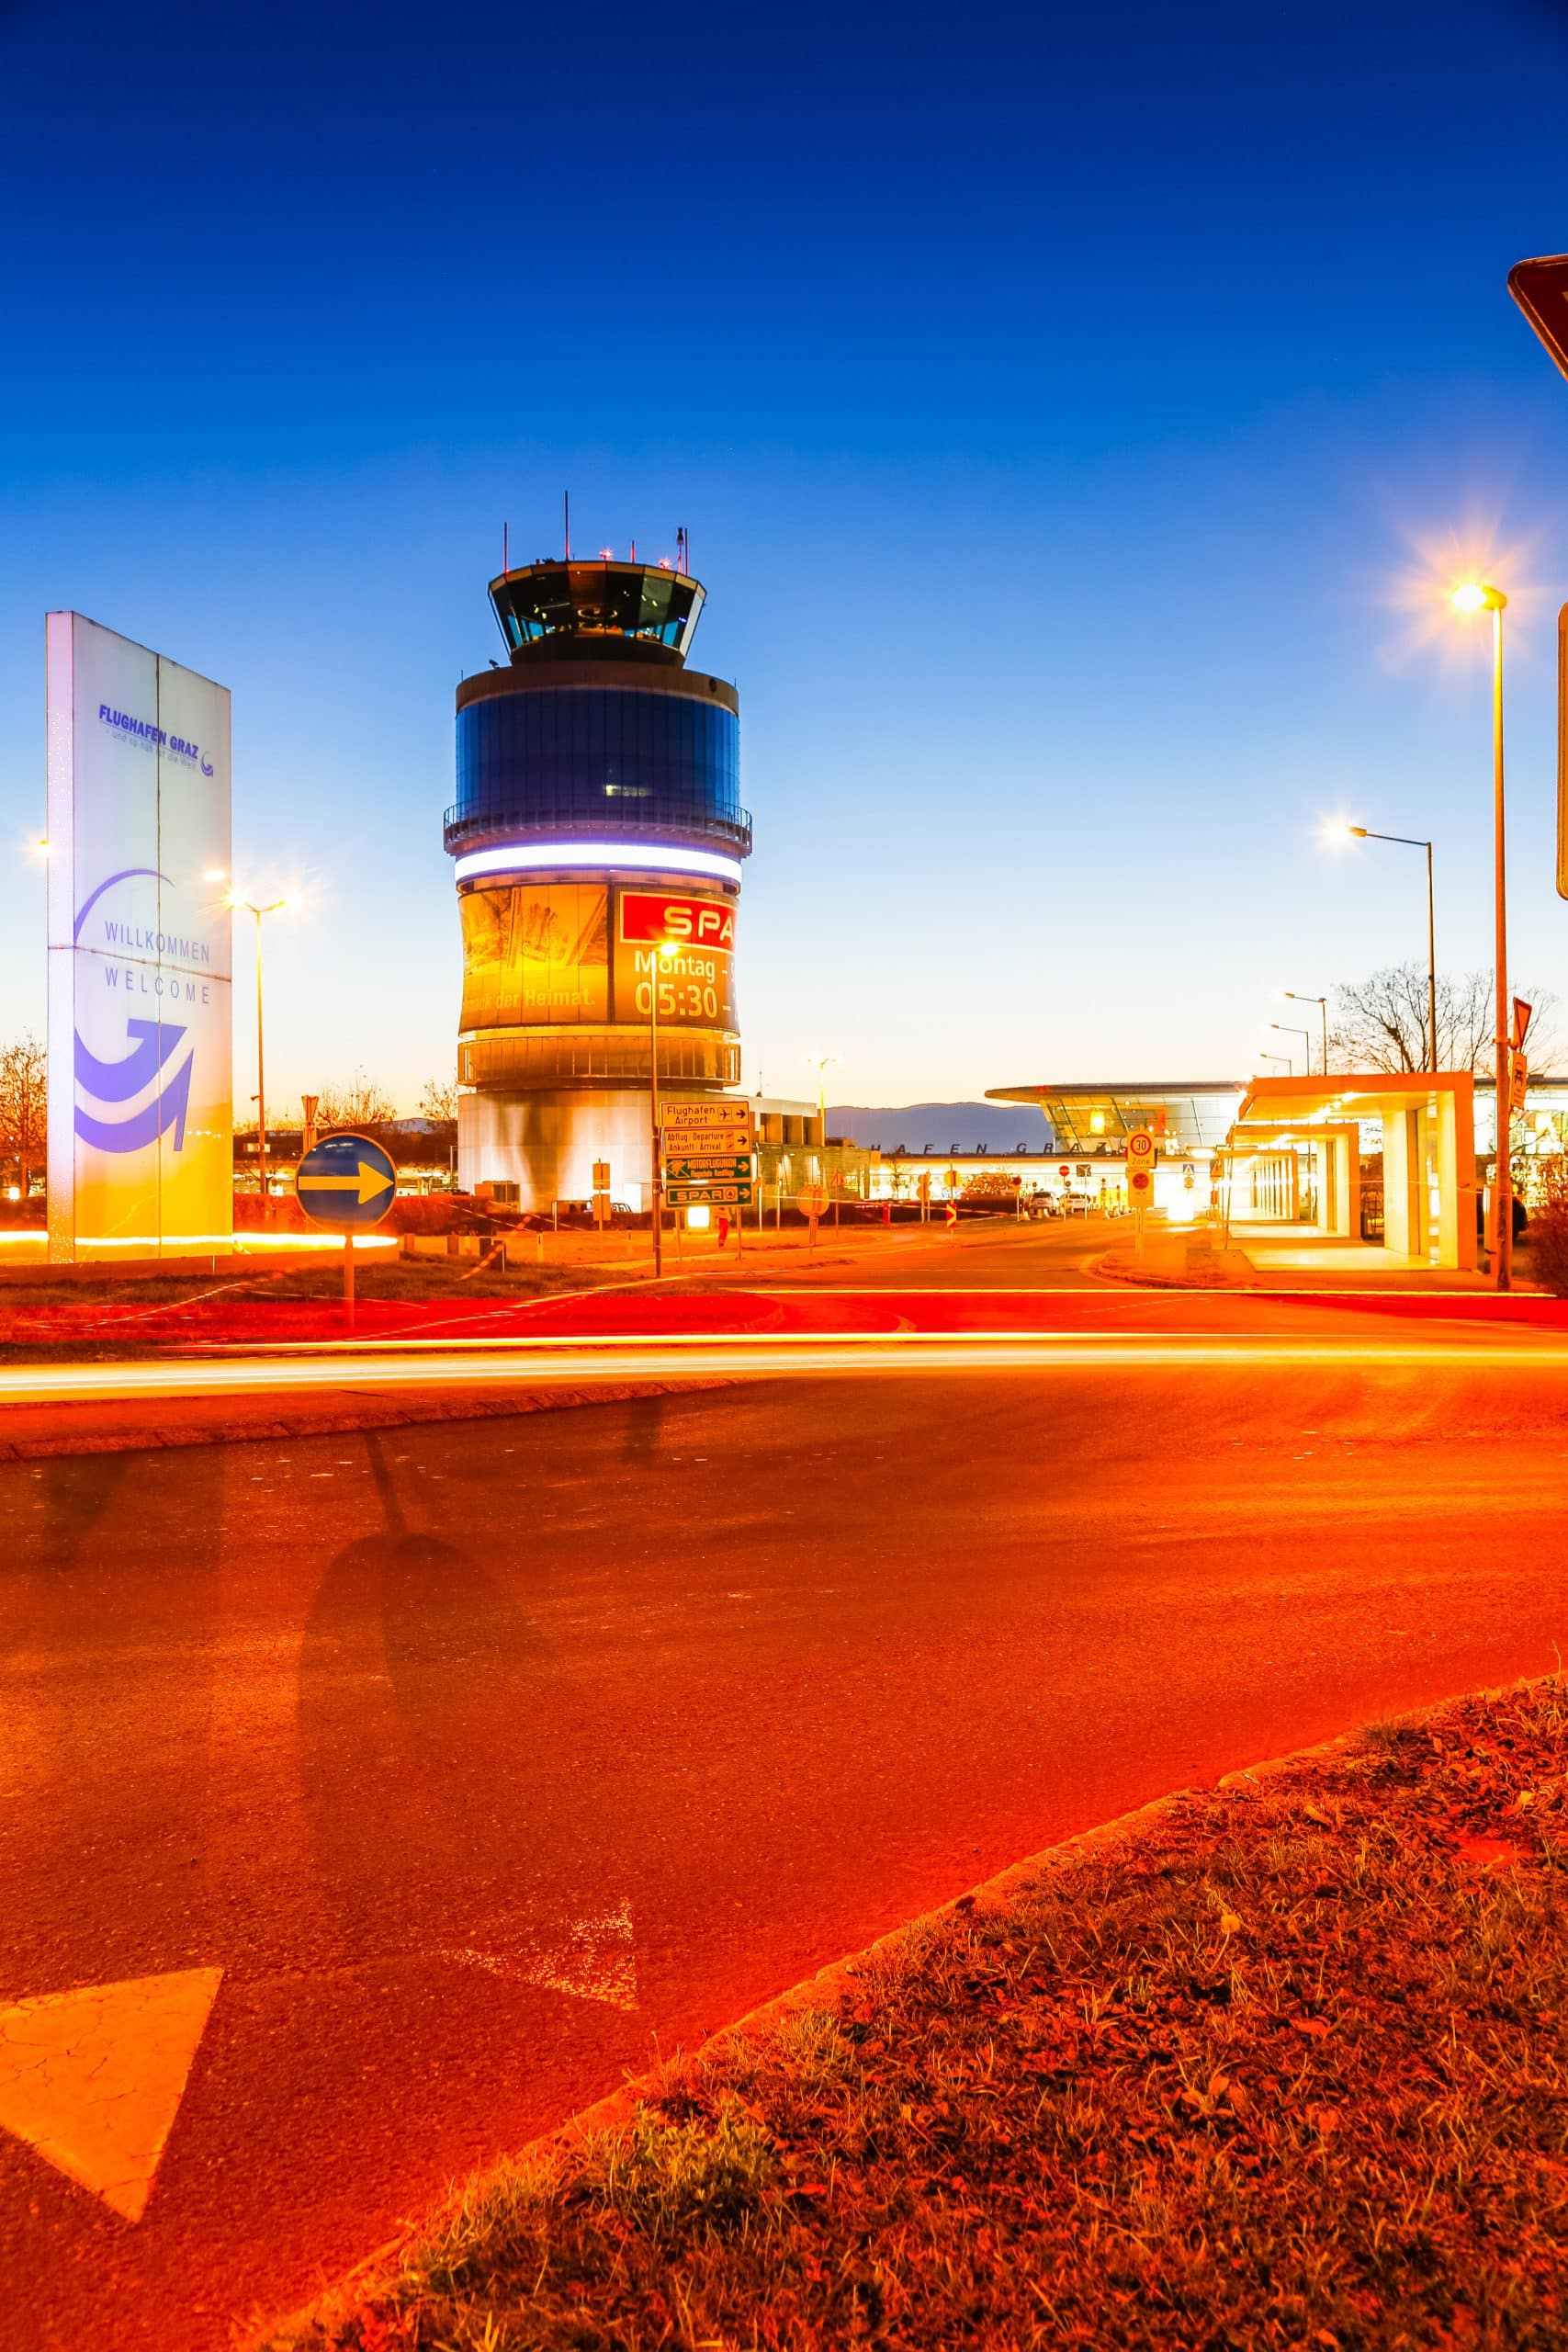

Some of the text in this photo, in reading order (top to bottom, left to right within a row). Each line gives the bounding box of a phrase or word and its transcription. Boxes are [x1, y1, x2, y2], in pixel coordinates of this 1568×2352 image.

[99, 704, 198, 759] FLUGHAFEN GRAZ
[105, 920, 210, 963] WILLKOMMEN
[635, 950, 715, 984] Montag
[105, 967, 210, 1004] WELCOME
[496, 989, 520, 1008] der
[525, 987, 596, 1007] Heimat.
[635, 982, 717, 1018] 05:30
[667, 1105, 715, 1117] Flughafen
[675, 1116, 707, 1125] Airport
[667, 1132, 724, 1142] Abflug Departure
[669, 1142, 721, 1151] Ankunft Arrival
[1016, 1142, 1107, 1154] GRAZ
[1136, 1140, 1146, 1151] 30
[1132, 1158, 1150, 1166] Zone
[677, 1190, 723, 1201] SPAR
